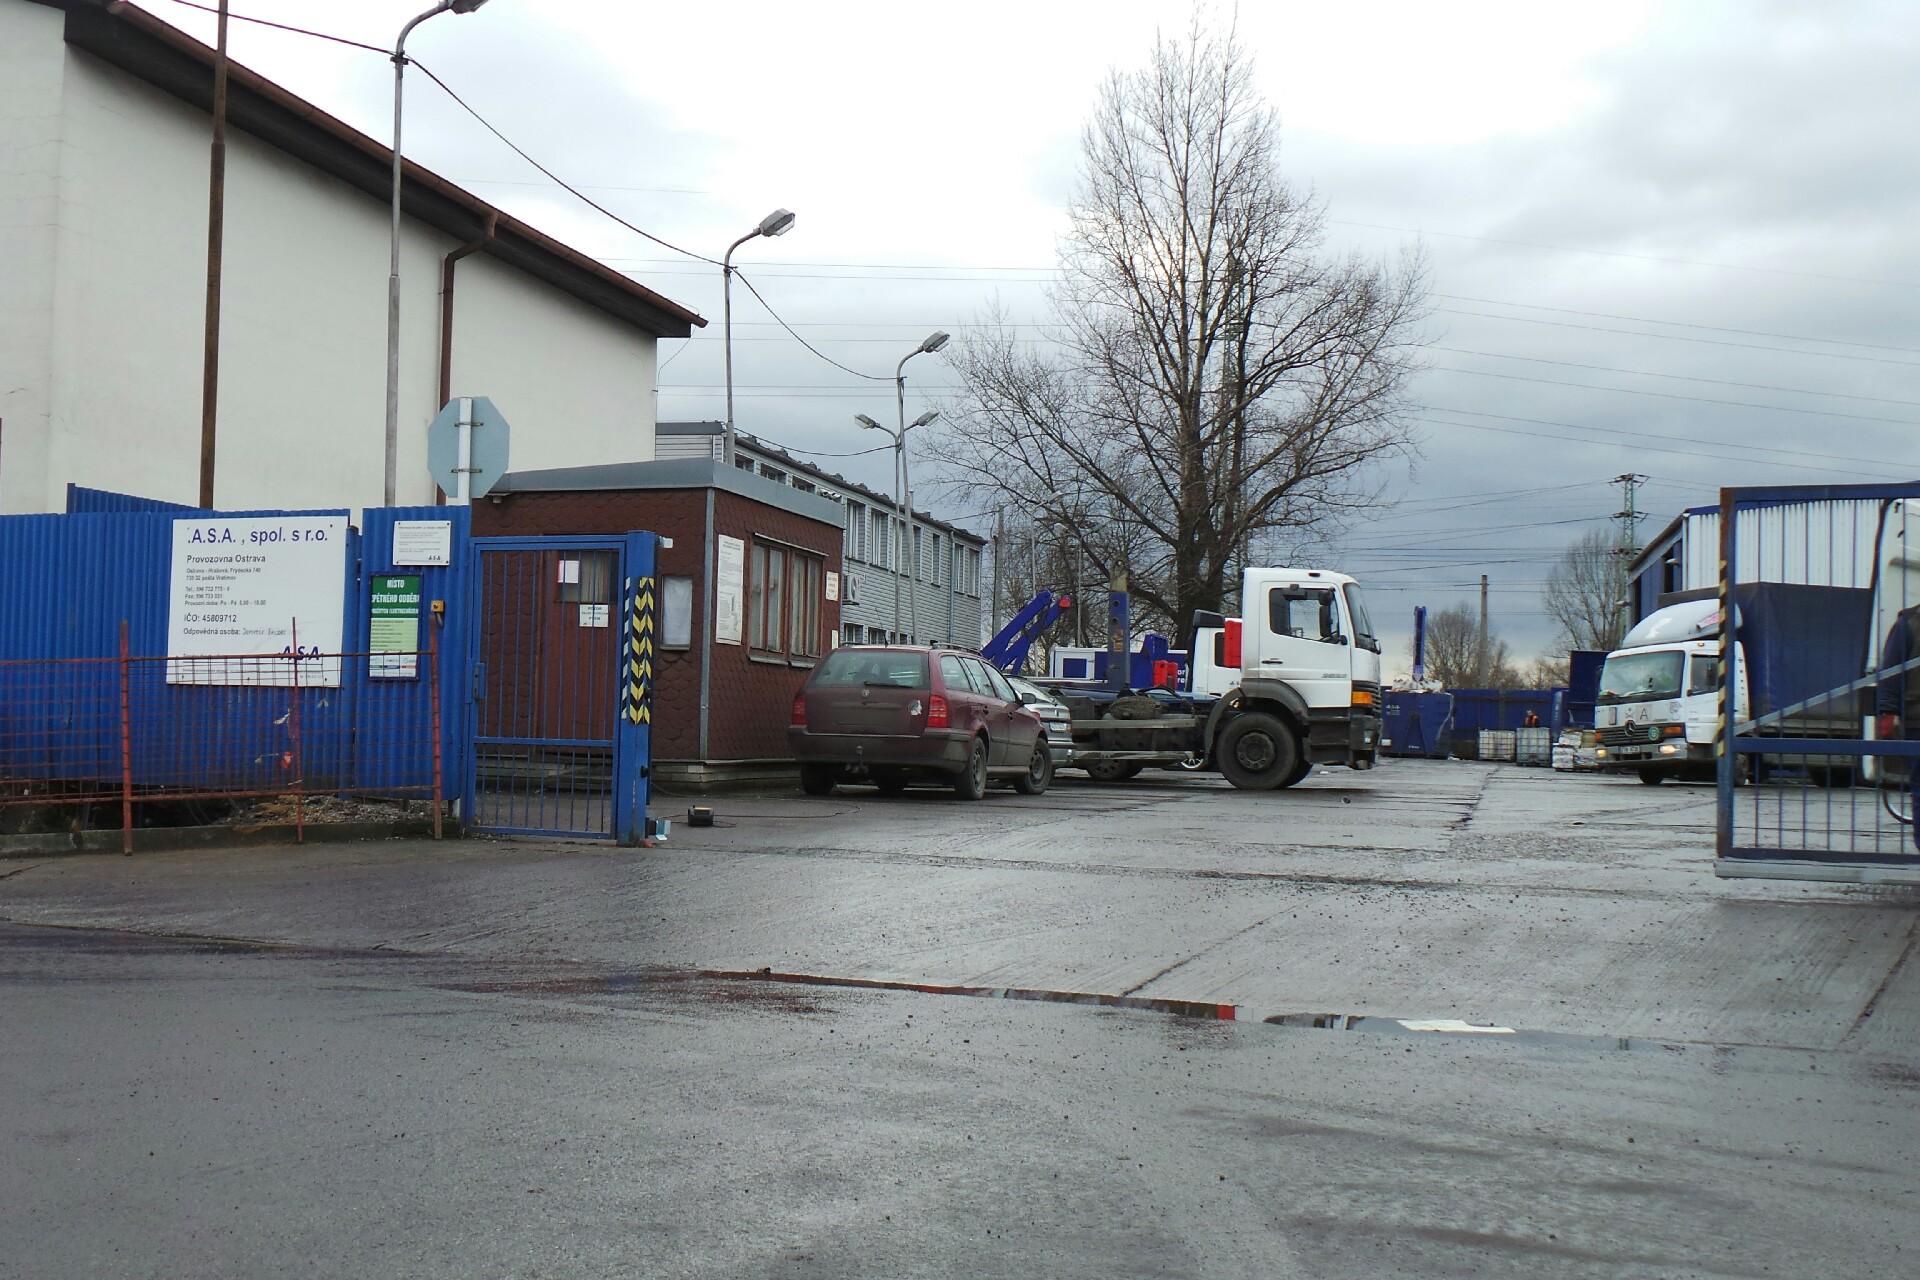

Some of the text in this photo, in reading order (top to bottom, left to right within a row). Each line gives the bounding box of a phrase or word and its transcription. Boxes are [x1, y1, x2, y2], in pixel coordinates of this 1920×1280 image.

[250, 527, 286, 546] spol.
[291, 529, 300, 541] s
[305, 528, 328, 541] r.o.
[186, 553, 266, 563] Provozovna Ostrava
[386, 578, 405, 588] MÍSTO
